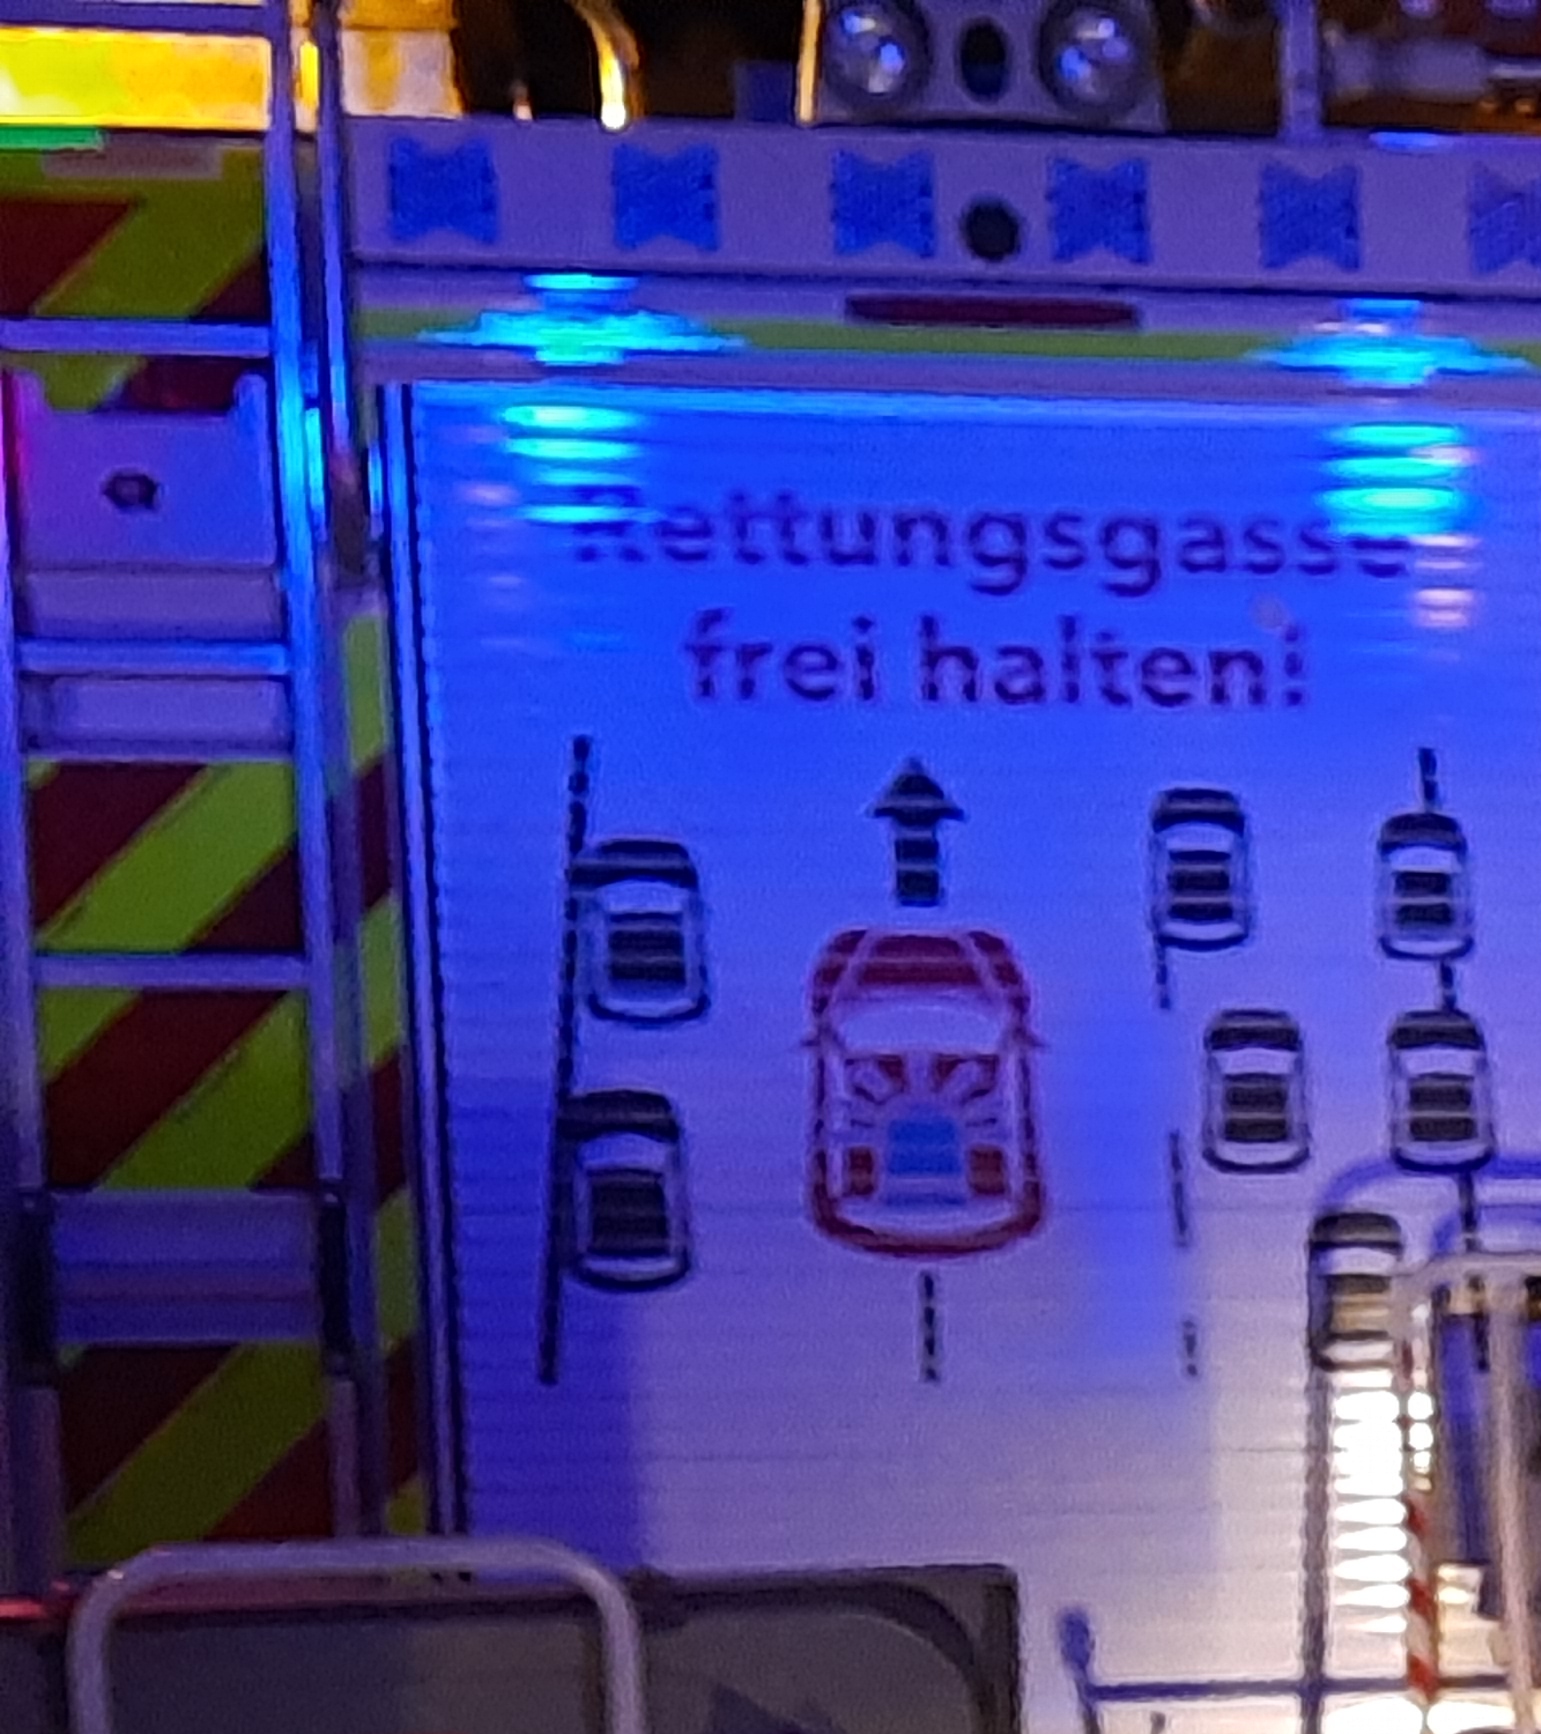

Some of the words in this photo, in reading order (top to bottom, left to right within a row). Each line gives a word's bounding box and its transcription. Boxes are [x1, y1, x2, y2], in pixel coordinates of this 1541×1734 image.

[574, 484, 1412, 597] Rettungsgasse
[683, 607, 876, 702] frei
[918, 612, 1303, 708] halten!
